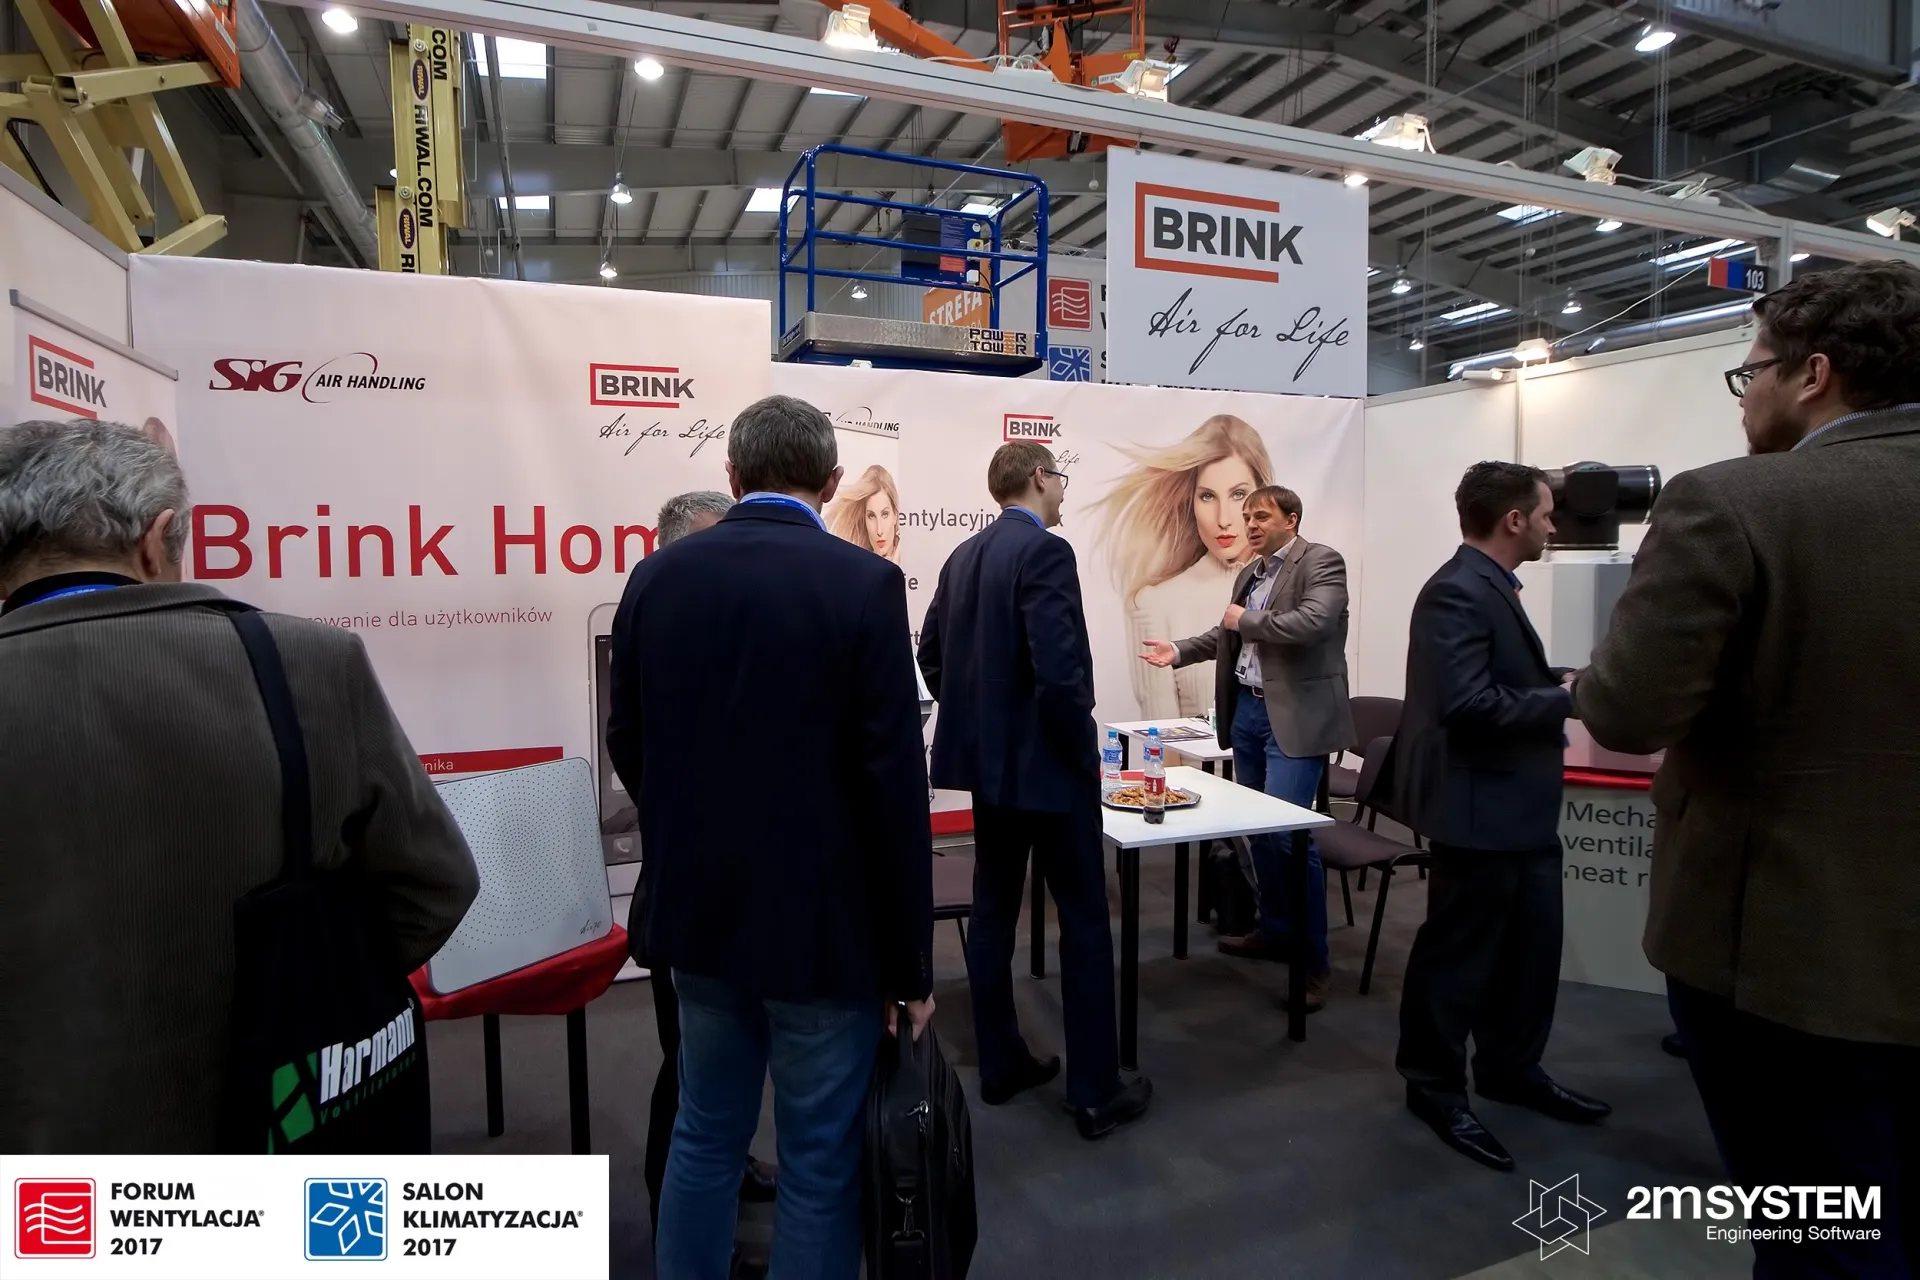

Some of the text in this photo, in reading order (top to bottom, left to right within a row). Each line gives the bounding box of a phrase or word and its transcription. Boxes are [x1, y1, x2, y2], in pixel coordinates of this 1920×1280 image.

[431, 29, 448, 80] COM
[414, 104, 434, 228] RIWAL.COM
[1153, 206, 1304, 266] BRINK
[401, 253, 415, 274] RI
[1744, 268, 1765, 290] 103
[969, 328, 1027, 344] POWER
[969, 340, 1027, 355] TOWER
[1148, 287, 1201, 338] Air
[1189, 308, 1262, 376] for
[1276, 306, 1349, 383] Life
[38, 355, 108, 408] BRINK
[315, 374, 426, 390] AIR HANDLING
[601, 374, 695, 399] BRINK
[599, 413, 726, 458] Air for Life
[1009, 421, 1062, 437] BRINK
[899, 508, 1000, 532] entylacyjn
[191, 504, 659, 580] Brink Hom
[388, 610, 418, 627] dla
[425, 606, 553, 629] użytkowników
[422, 758, 454, 771] nika
[1566, 801, 1657, 829] Mecha
[1564, 834, 1654, 859] ventila
[319, 1005, 416, 1105] Harmann
